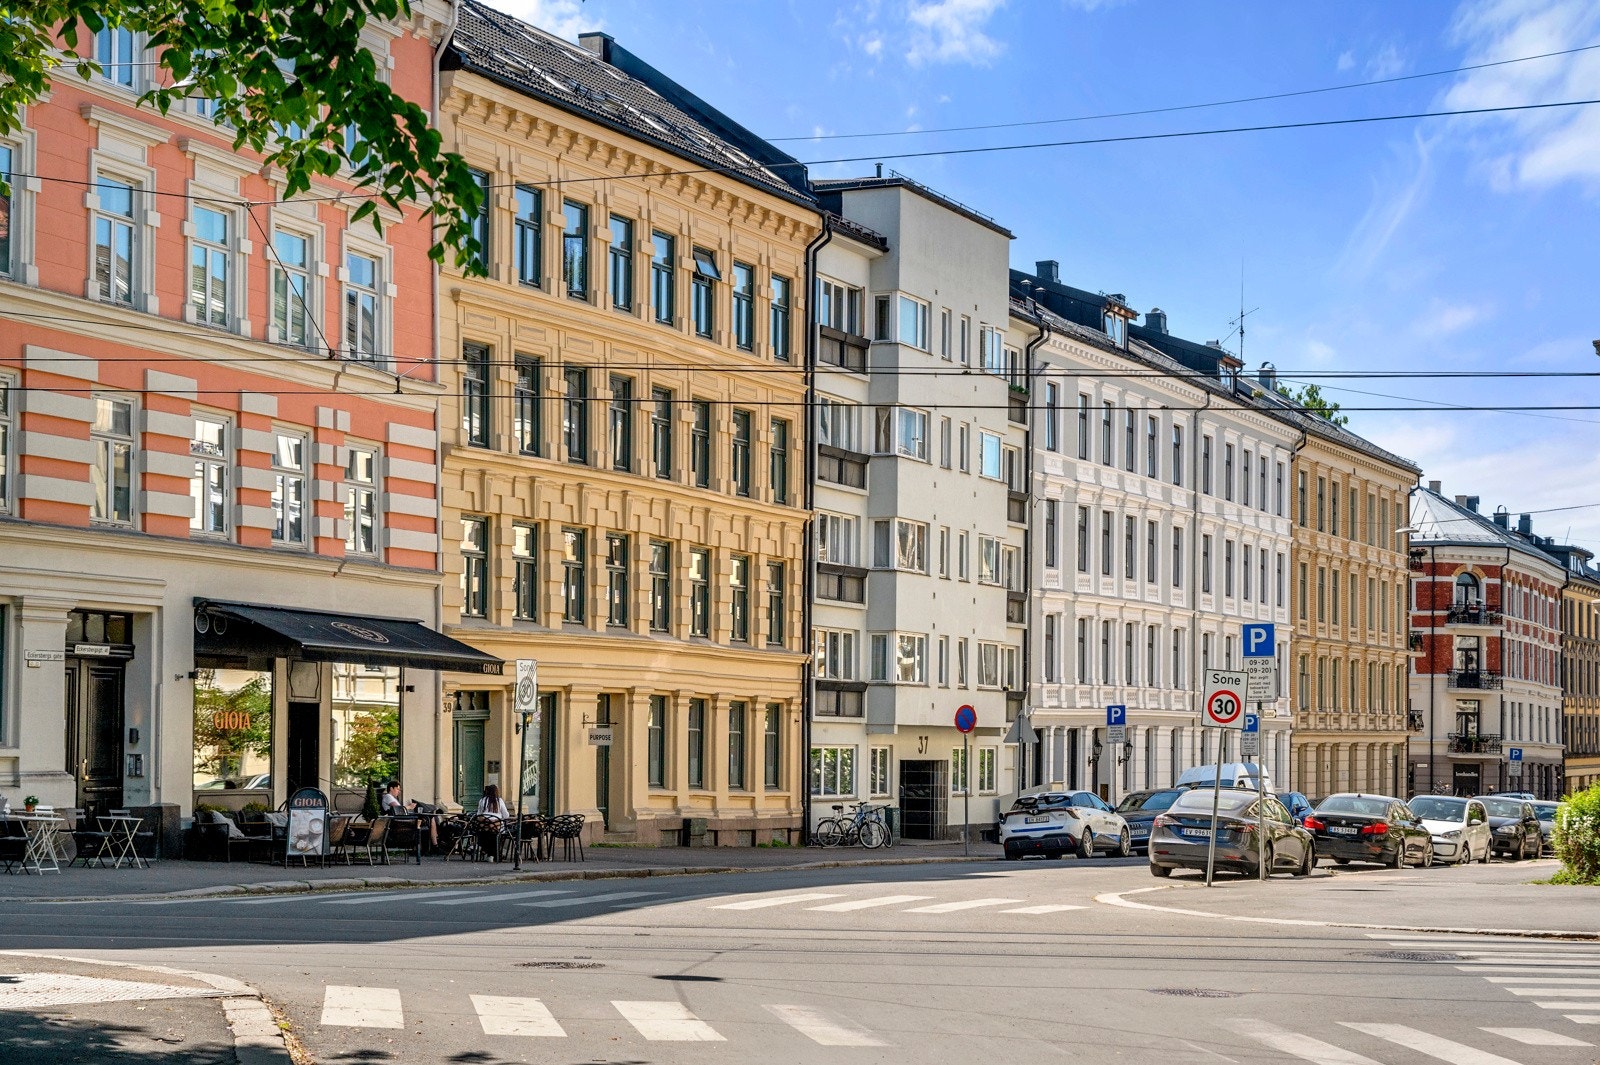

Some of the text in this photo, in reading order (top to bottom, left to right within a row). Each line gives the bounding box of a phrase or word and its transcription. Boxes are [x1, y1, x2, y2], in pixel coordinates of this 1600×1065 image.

[1250, 628, 1267, 653] P
[483, 663, 500, 674] GIOIA
[1212, 673, 1241, 685] Sone
[443, 702, 452, 713] 39
[1213, 698, 1235, 716] 30
[213, 710, 251, 730] GIOIA
[917, 735, 929, 755] 37
[294, 798, 323, 807] GIOIA
